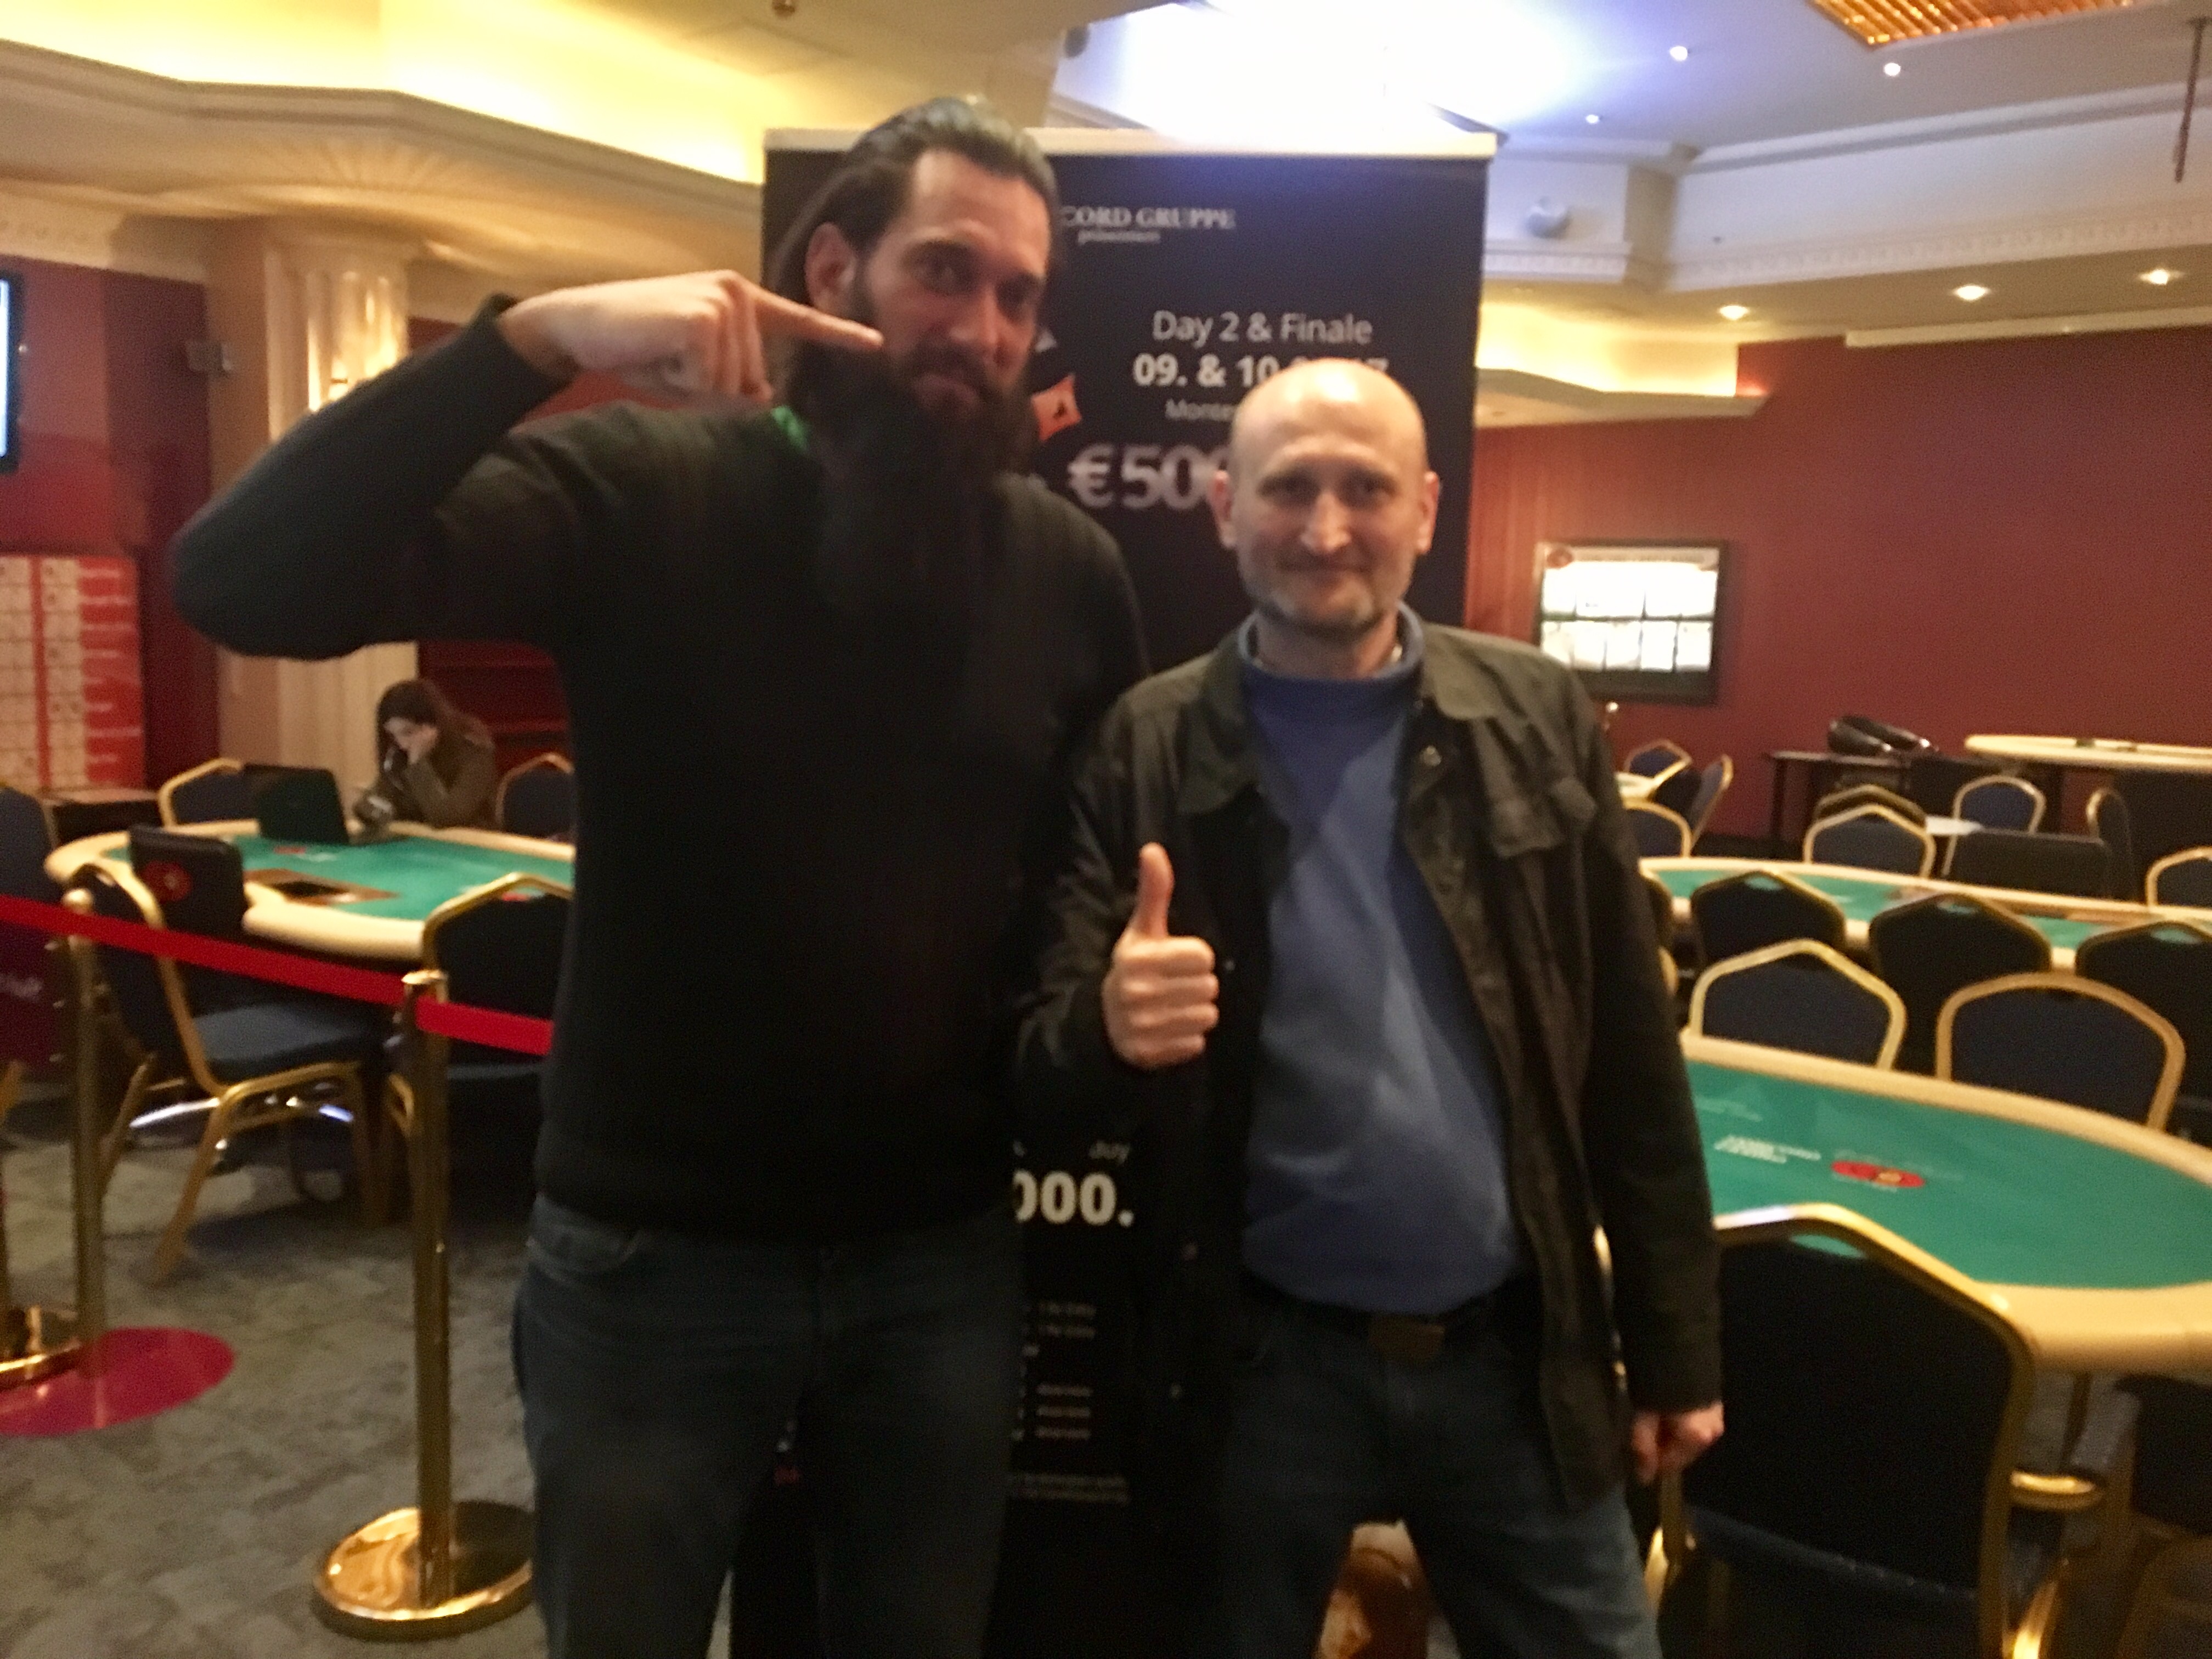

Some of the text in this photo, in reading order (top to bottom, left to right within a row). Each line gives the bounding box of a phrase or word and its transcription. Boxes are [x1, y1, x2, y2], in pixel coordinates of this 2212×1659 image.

[1153, 310, 1373, 349] Day 2 & Finale
[1132, 353, 1188, 386] 09.
[1197, 353, 1227, 386] &
